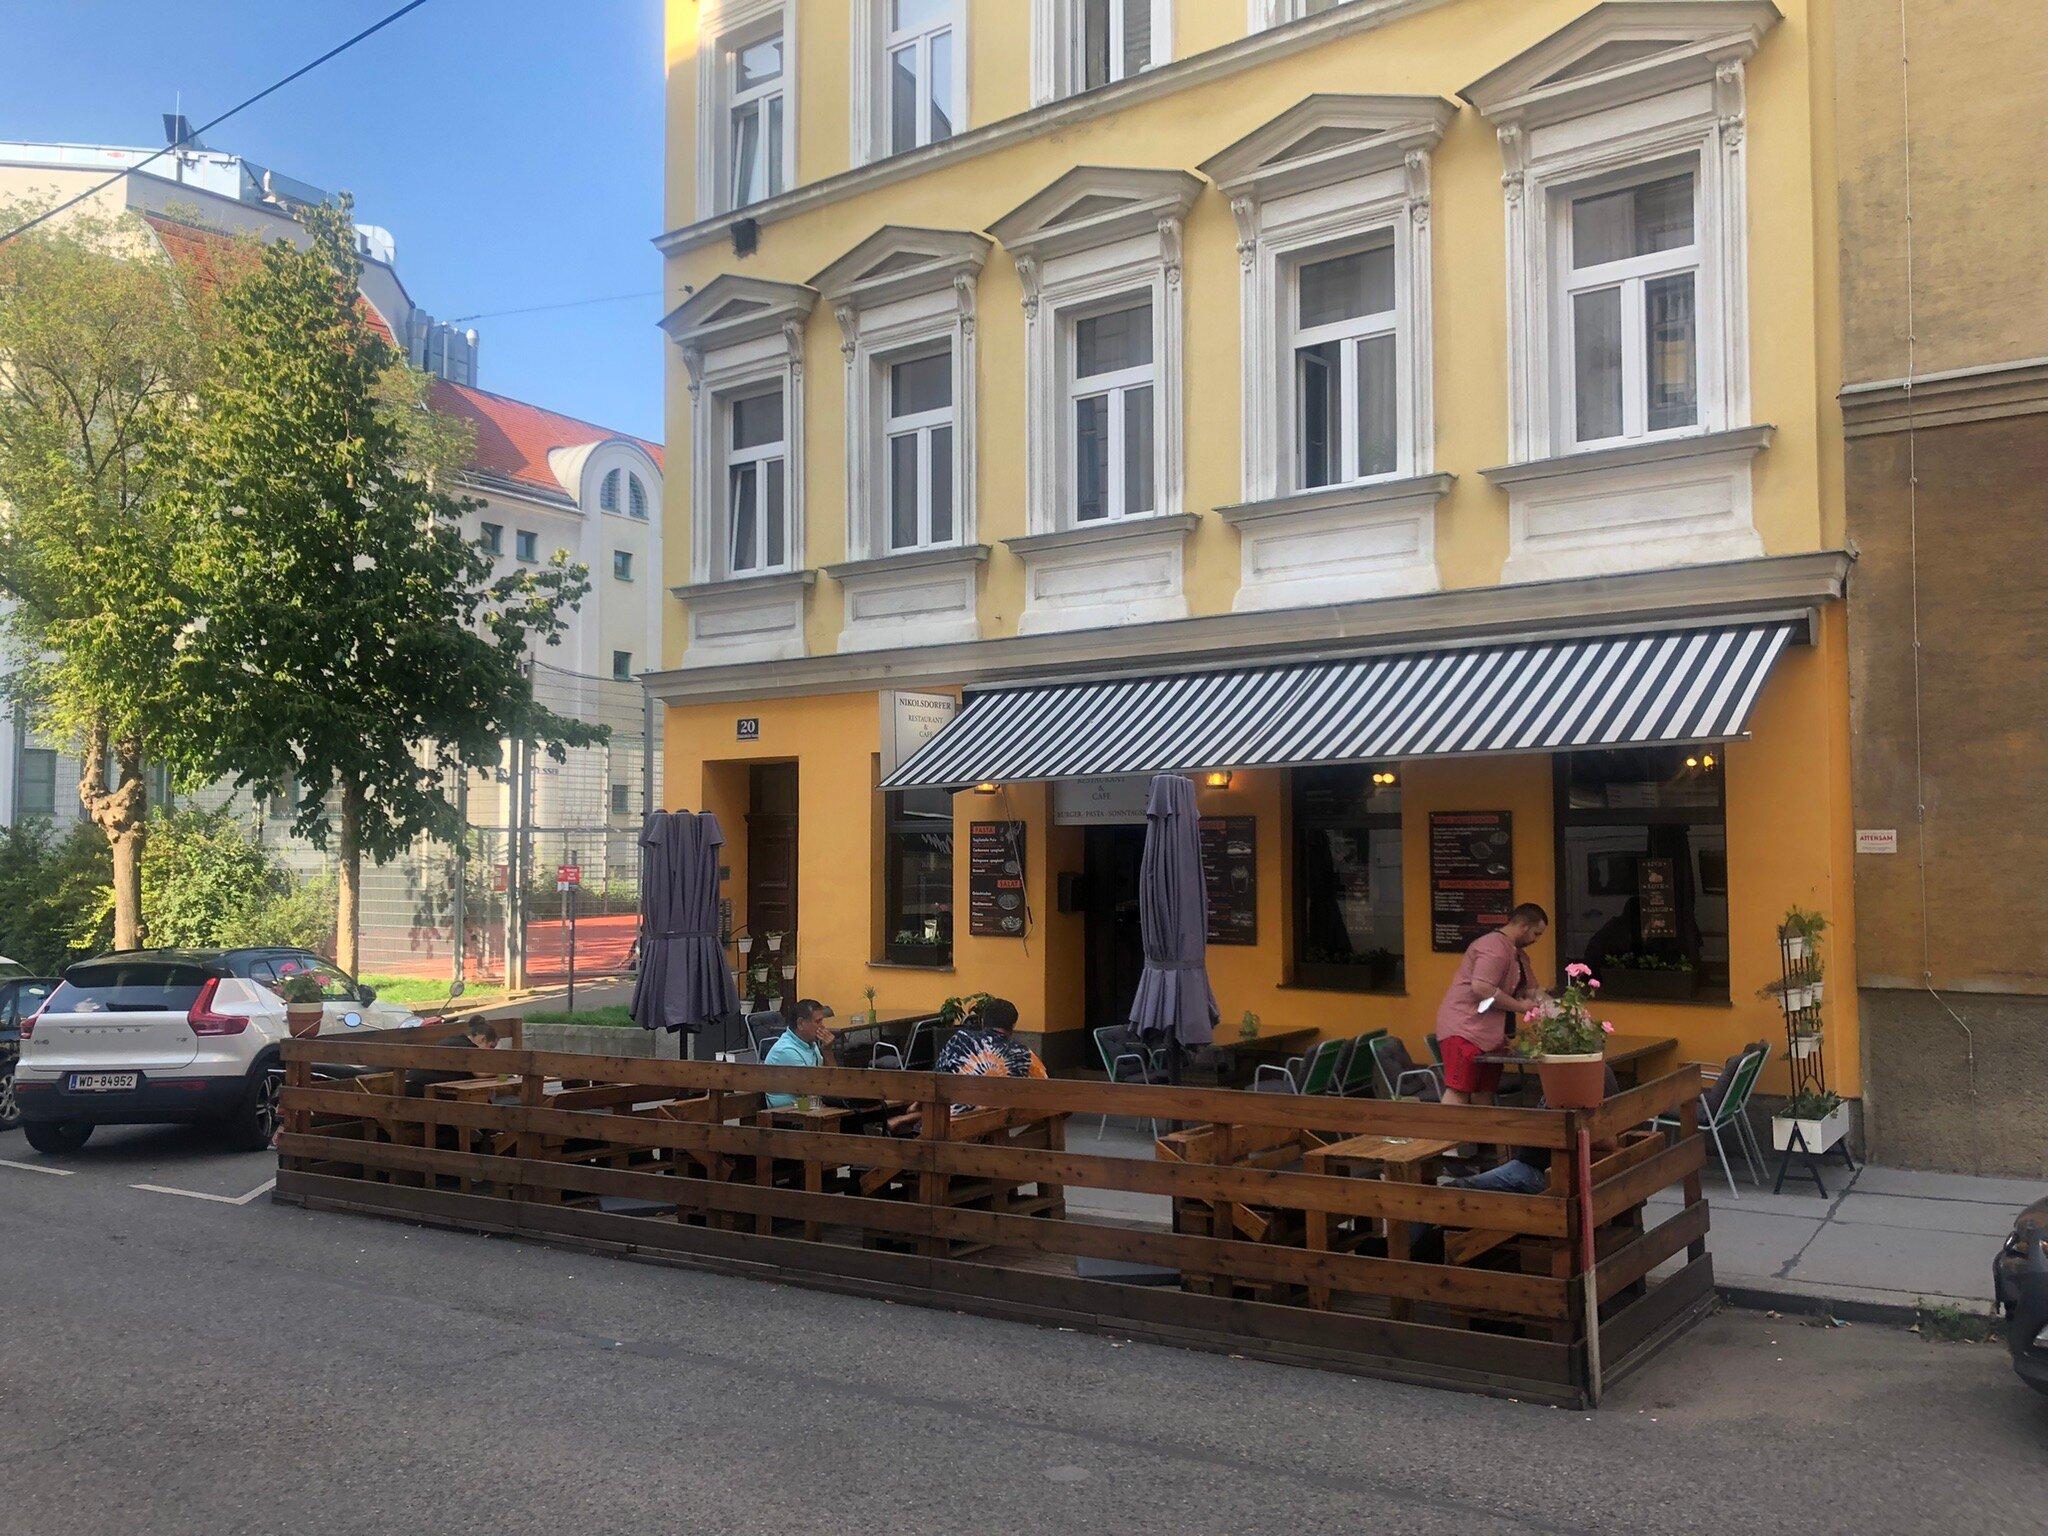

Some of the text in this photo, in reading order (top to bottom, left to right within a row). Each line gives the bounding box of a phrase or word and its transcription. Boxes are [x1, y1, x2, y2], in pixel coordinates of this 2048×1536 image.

[899, 698, 952, 710] NIKOLSDORFER
[908, 714, 944, 724] RESTAURANT
[740, 720, 756, 733] 20
[1077, 776, 1126, 784] RESTAURANT
[78, 1075, 133, 1087] WD-84952
